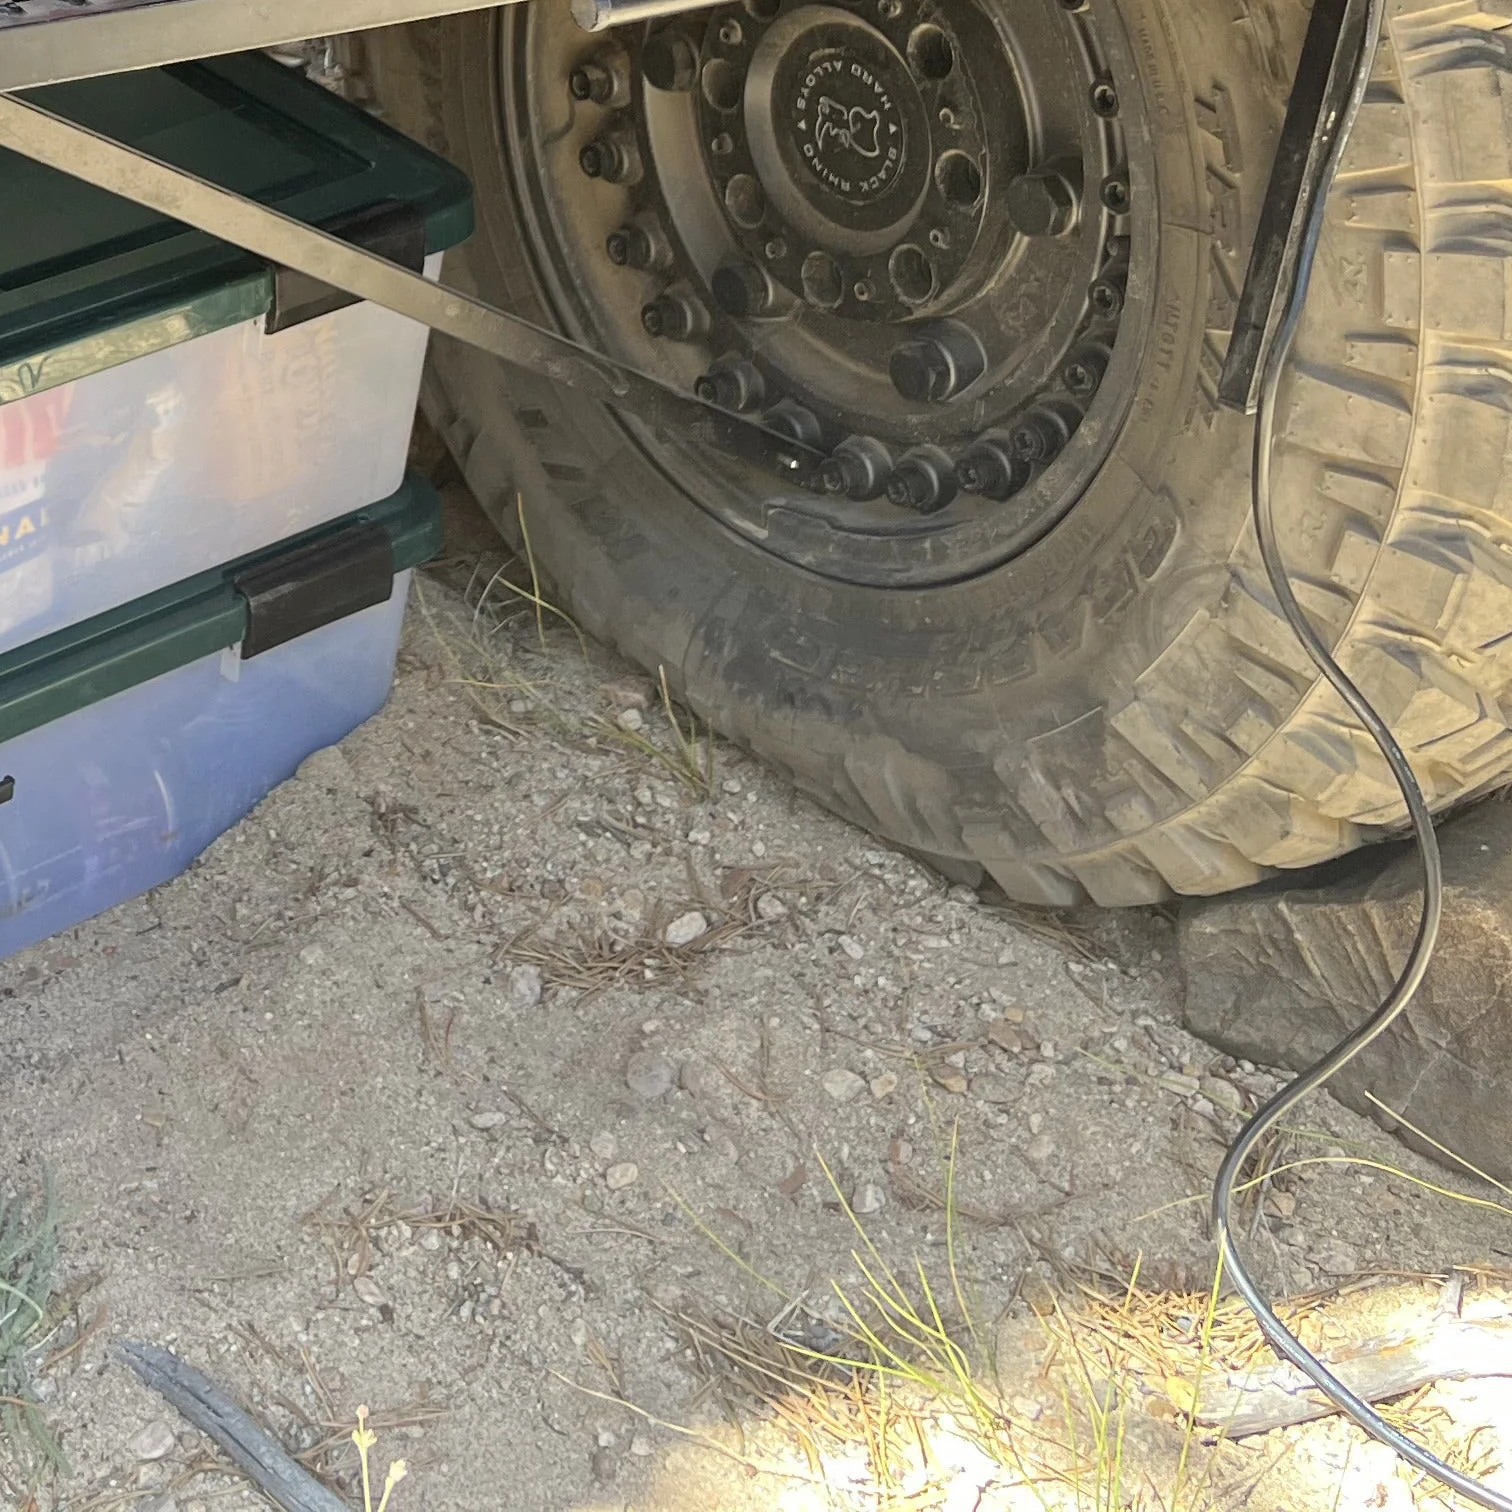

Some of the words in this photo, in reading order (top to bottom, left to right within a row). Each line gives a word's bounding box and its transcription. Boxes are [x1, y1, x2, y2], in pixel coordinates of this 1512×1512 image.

[796, 60, 842, 110] ALLOYS
[851, 63, 892, 110] HARD
[803, 143, 850, 192] RHINO
[859, 146, 898, 192] BLACK
